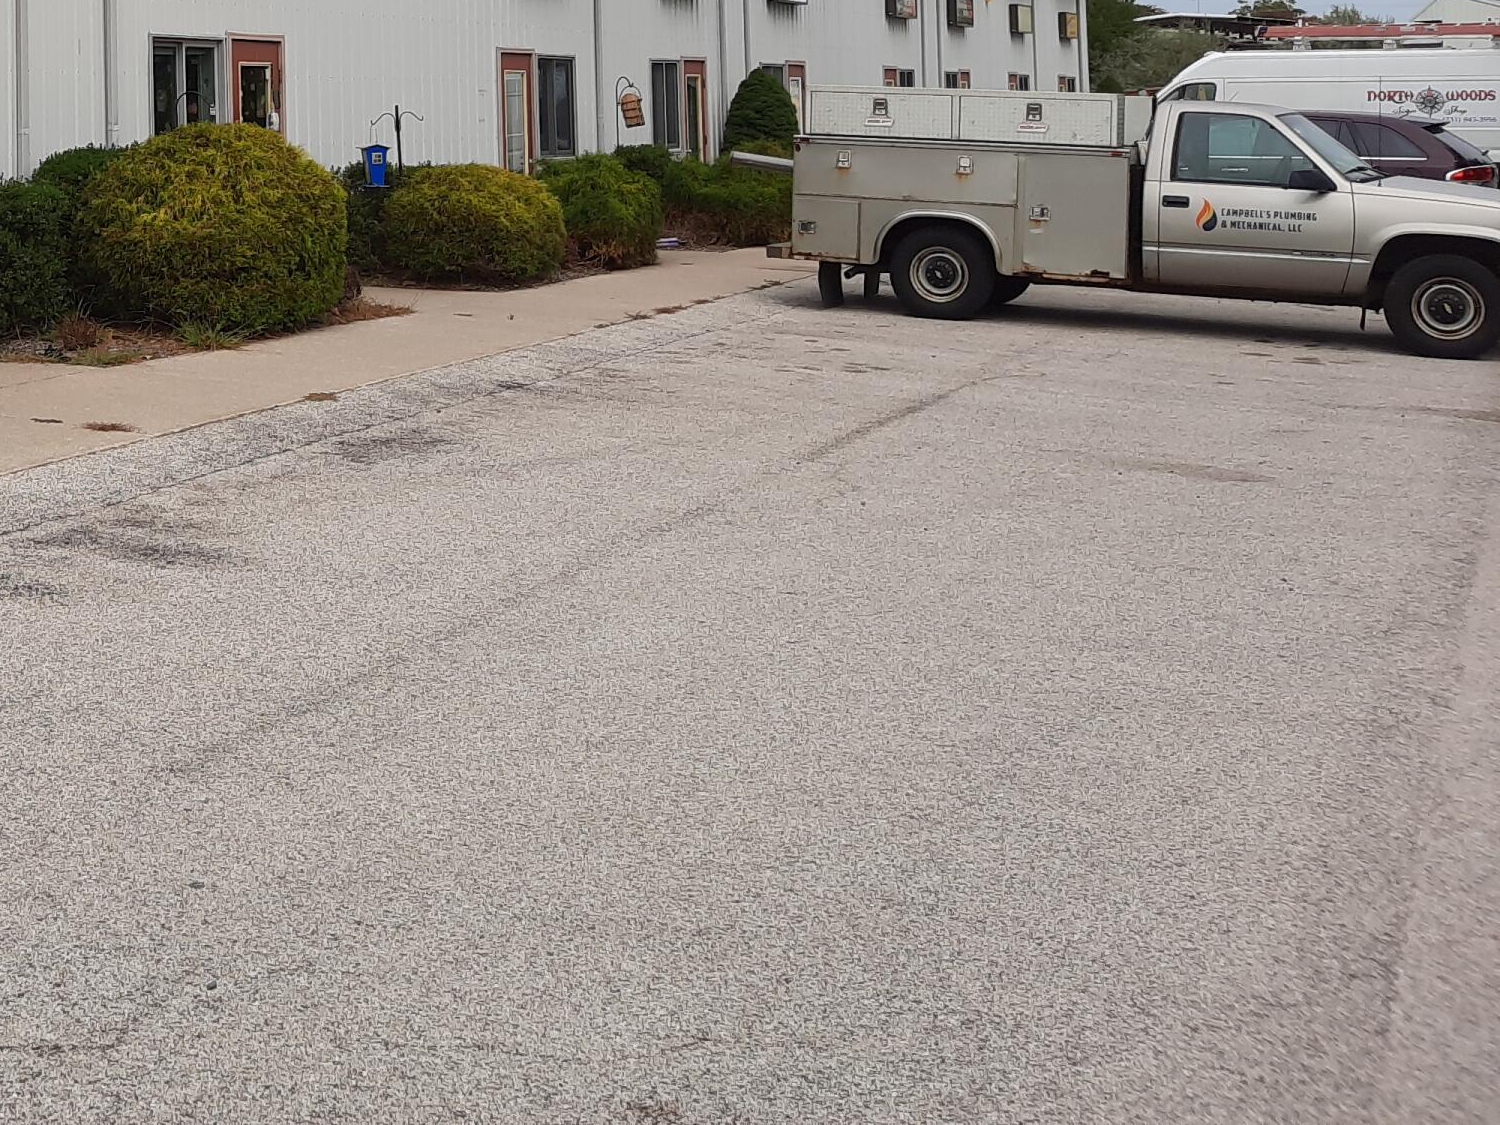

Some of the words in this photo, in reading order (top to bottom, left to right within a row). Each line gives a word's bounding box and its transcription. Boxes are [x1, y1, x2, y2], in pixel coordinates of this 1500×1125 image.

[1366, 90, 1414, 104] NORTH
[1445, 89, 1497, 101] WOODS
[1221, 207, 1271, 219] CAMPBELL'S
[1273, 210, 1318, 222] PLUMBING
[1220, 219, 1228, 229] &
[1288, 223, 1303, 233] LLC
